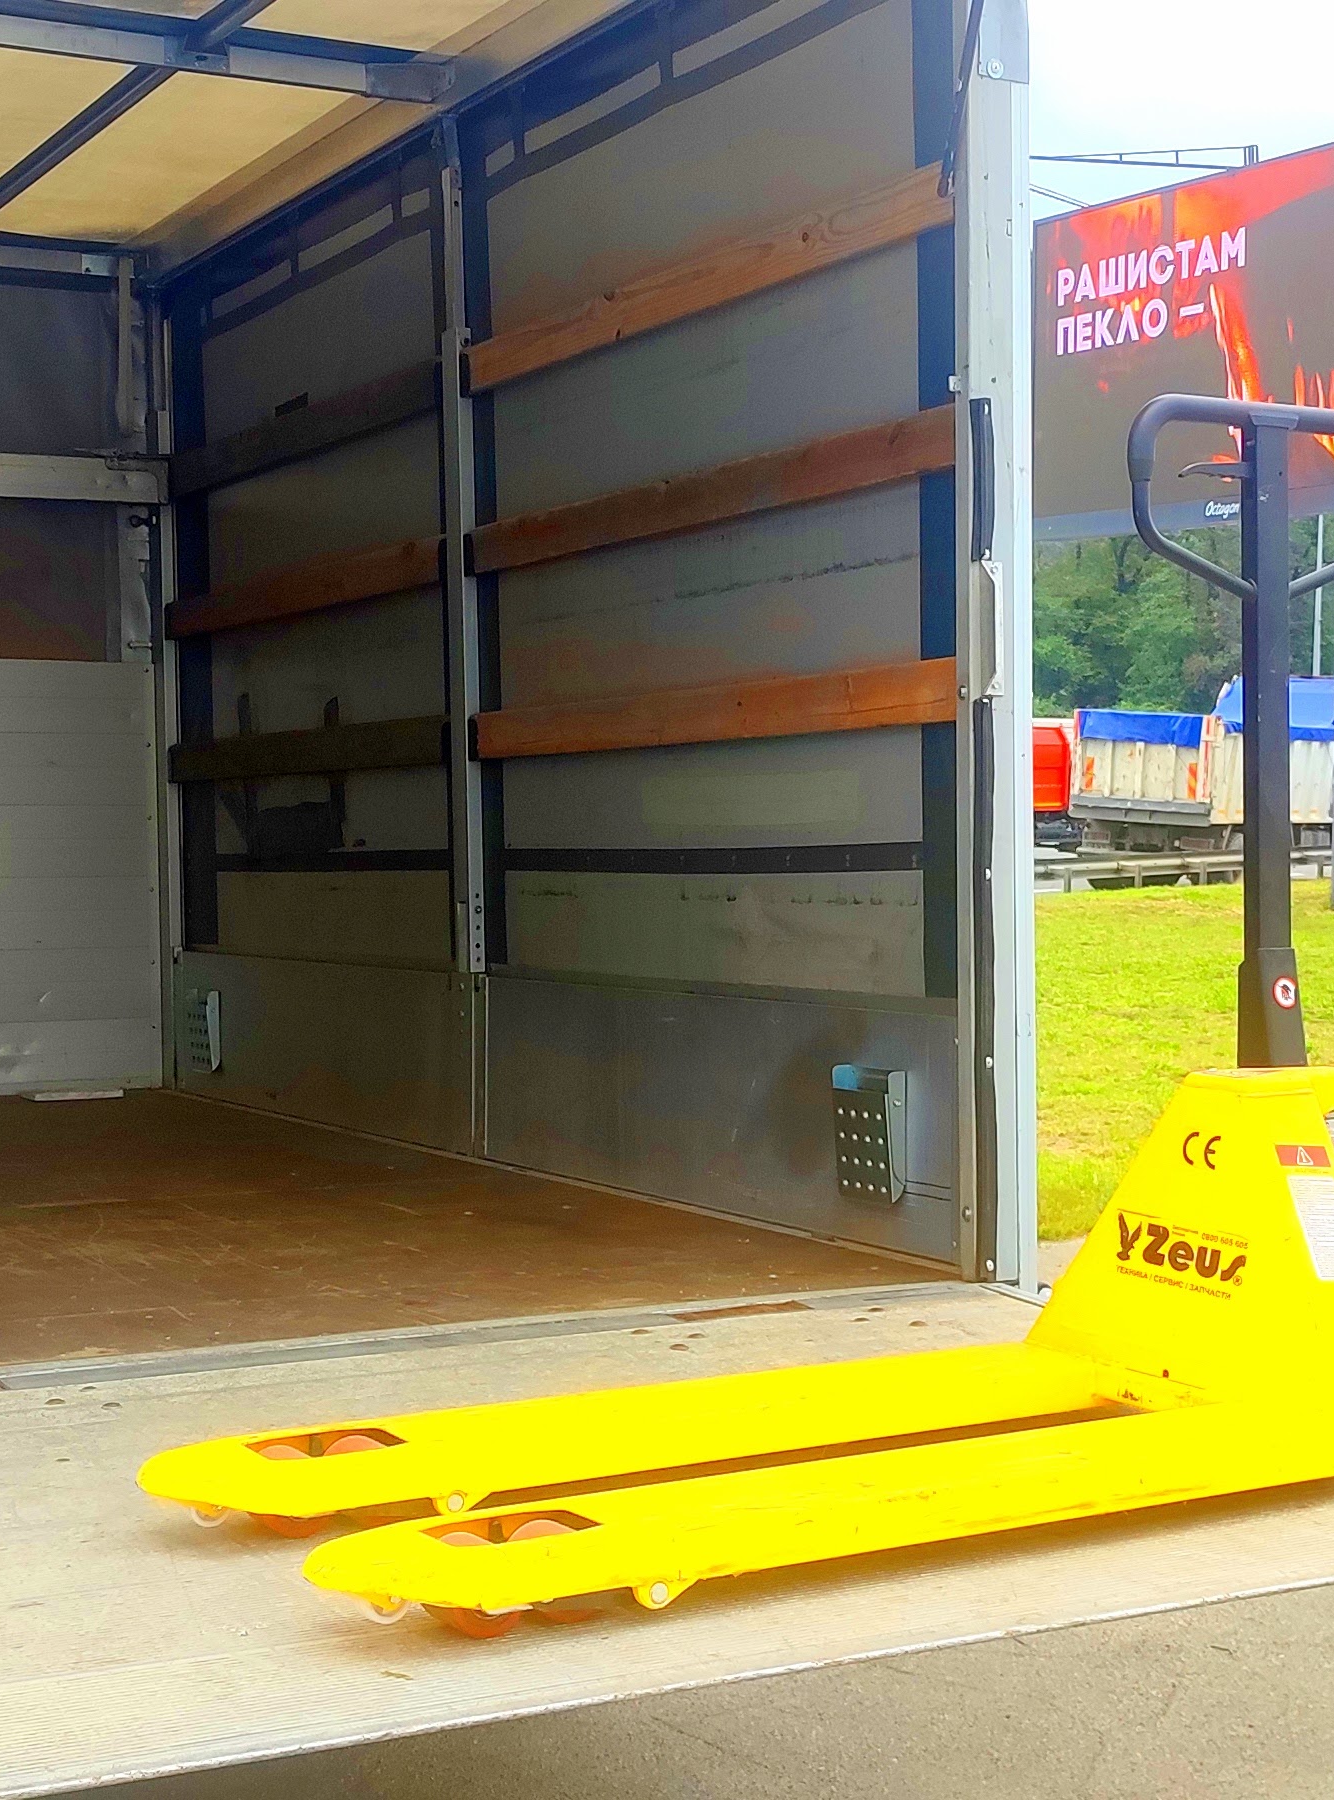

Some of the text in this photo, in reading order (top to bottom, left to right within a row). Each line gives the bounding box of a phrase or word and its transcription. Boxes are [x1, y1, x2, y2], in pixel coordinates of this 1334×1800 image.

[1056, 226, 1246, 307] РАШИСТАМ
[1056, 298, 1168, 356] ПЕКЛО
[1183, 1131, 1221, 1170] CE
[1142, 1223, 1247, 1282] Zeus
[1153, 1275, 1184, 1289] СЕРВИС
[1189, 1283, 1231, 1300] ЗАПЧАСТИ
